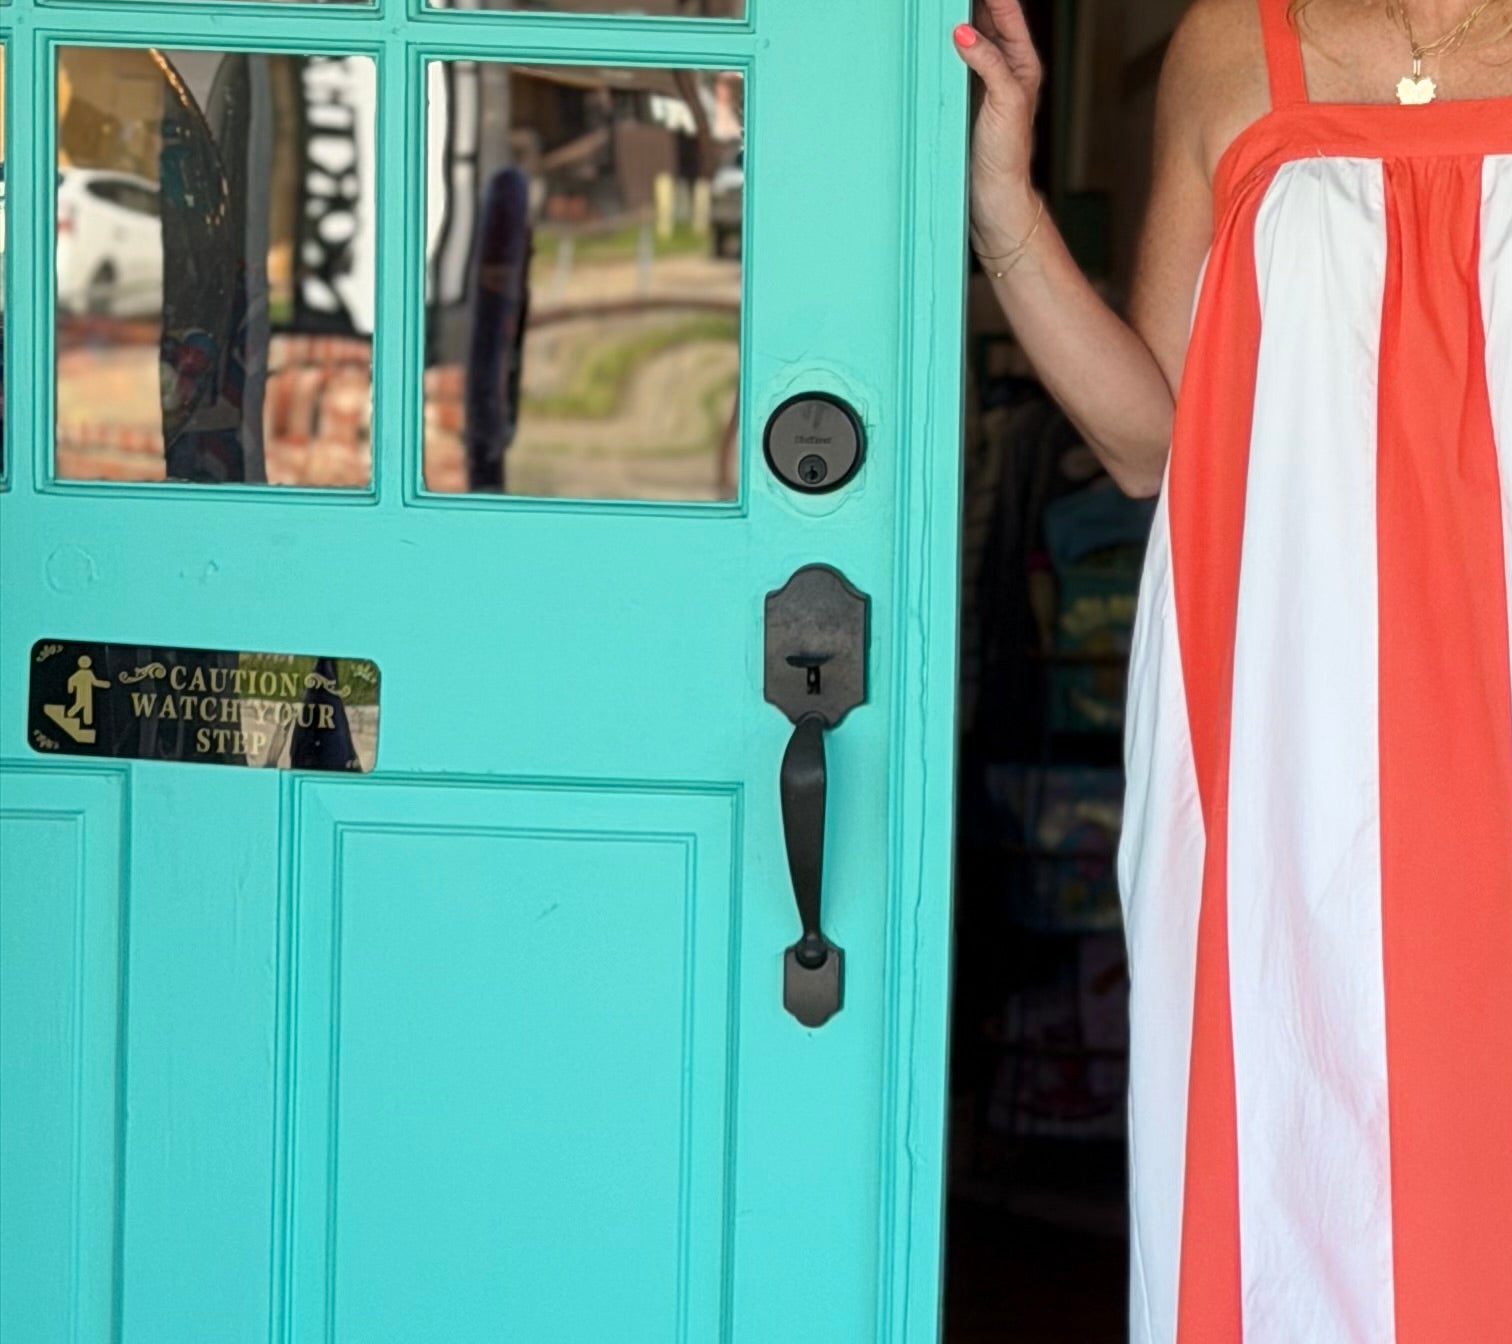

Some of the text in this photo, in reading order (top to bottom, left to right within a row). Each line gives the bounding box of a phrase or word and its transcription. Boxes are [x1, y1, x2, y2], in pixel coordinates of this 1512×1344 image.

[170, 666, 299, 697] CAUTION
[132, 693, 335, 729] WATCH YOUR
[197, 730, 266, 755] STEP
